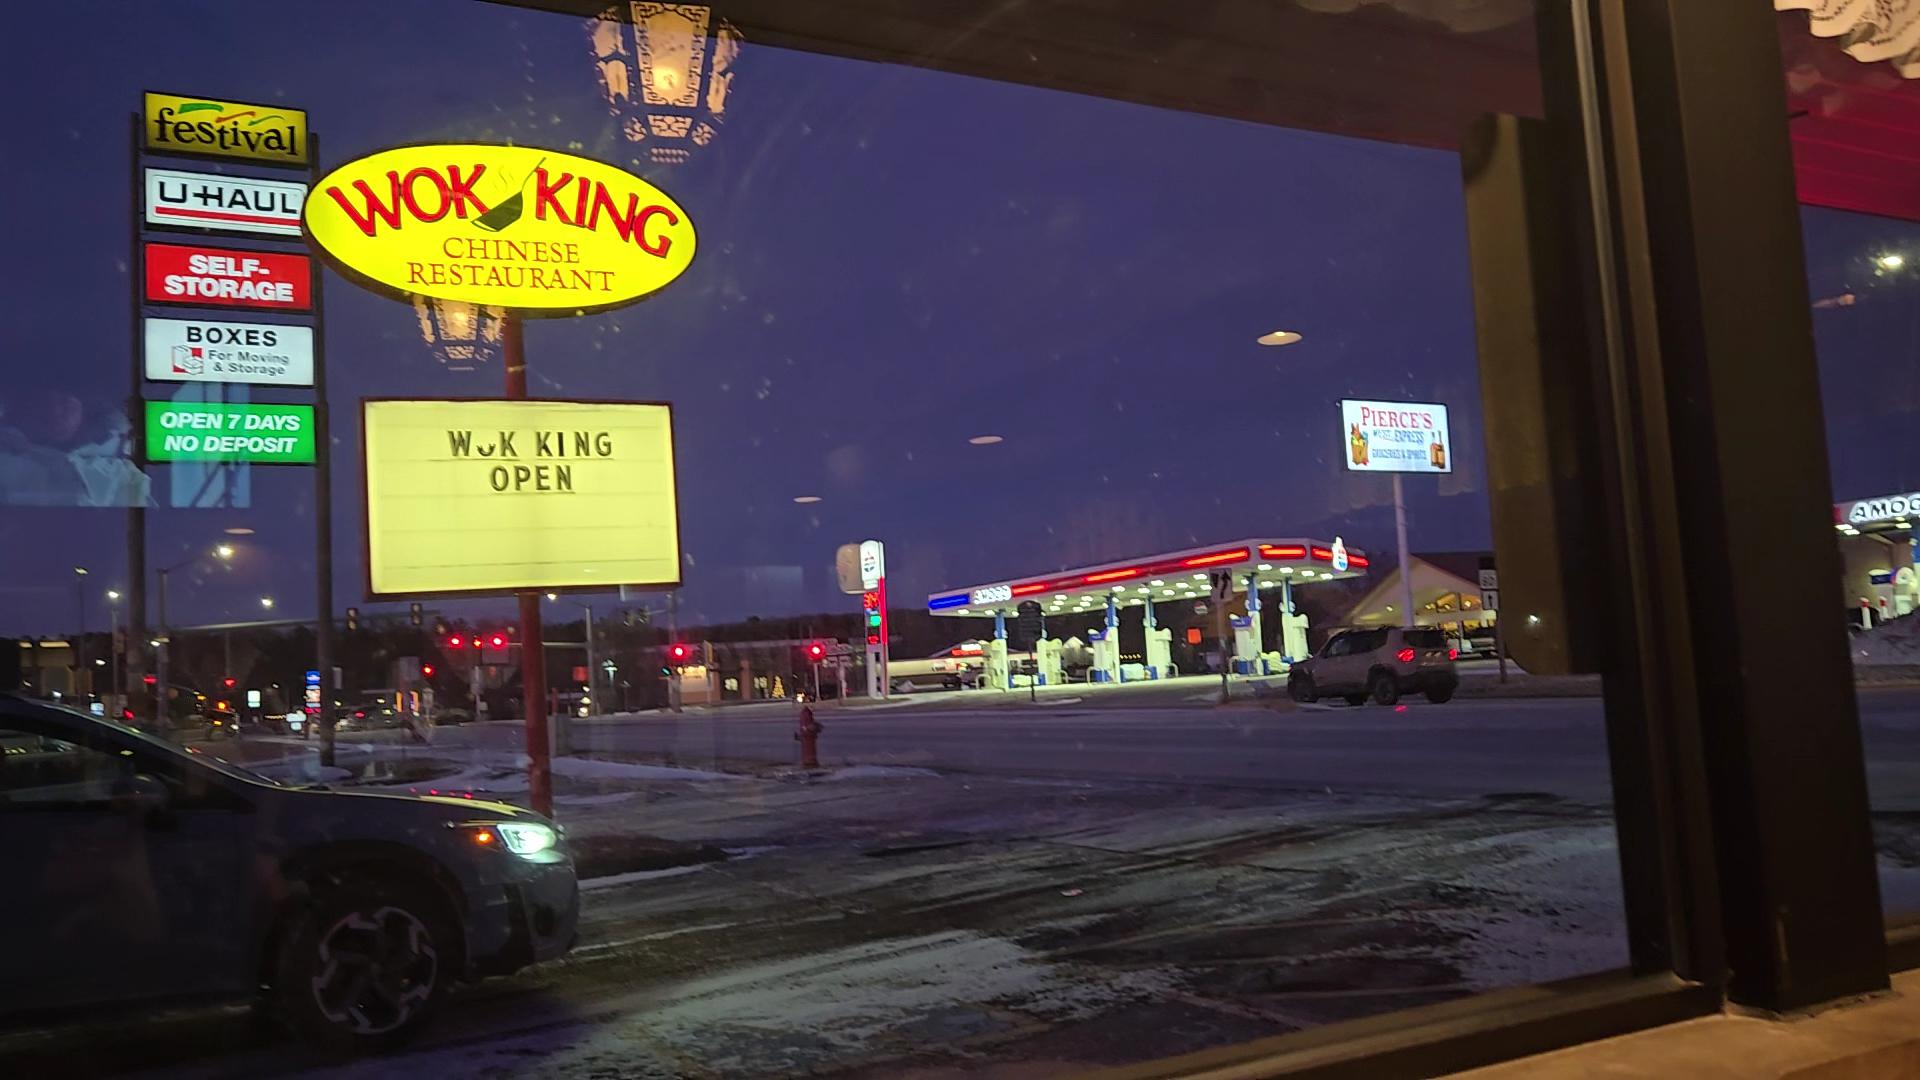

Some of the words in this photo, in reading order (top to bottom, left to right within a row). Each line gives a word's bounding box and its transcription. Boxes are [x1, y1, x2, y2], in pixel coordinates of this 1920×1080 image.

[153, 107, 299, 156] festival
[158, 181, 298, 215] U-HAUL
[326, 163, 492, 237] WOK
[535, 167, 679, 258] KING
[442, 237, 581, 264] CHINESE
[188, 254, 271, 278] SELF-
[406, 262, 616, 292] RESTAURANT
[164, 275, 295, 303] STORAGE
[186, 326, 278, 347] BOXES
[207, 350, 234, 362] For
[237, 351, 290, 366] Moving
[213, 361, 224, 373] &
[227, 361, 286, 377] Storage
[159, 412, 222, 430] OPEN
[227, 414, 242, 430] 7
[243, 414, 301, 431] DAYS
[1360, 406, 1433, 430] PIERCE'S
[164, 435, 199, 452] NO
[202, 437, 298, 454] DEPOSIT
[535, 431, 613, 458] KING
[489, 464, 573, 492] OPEN
